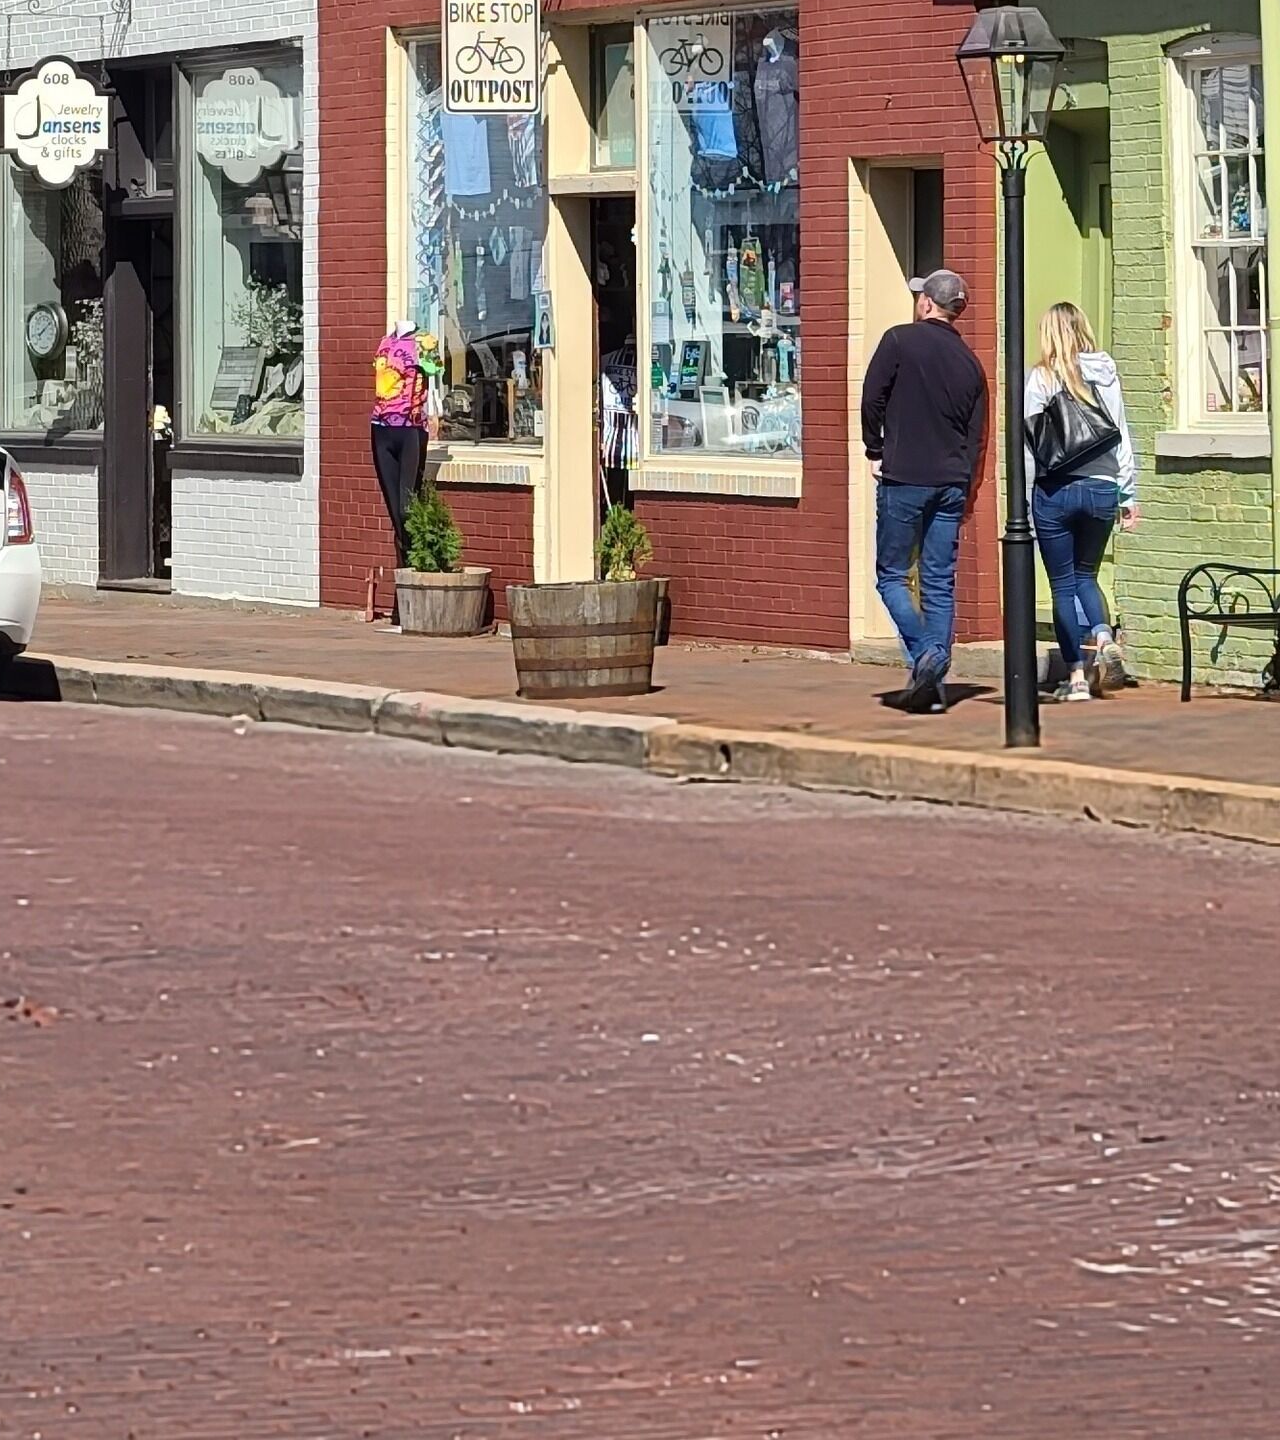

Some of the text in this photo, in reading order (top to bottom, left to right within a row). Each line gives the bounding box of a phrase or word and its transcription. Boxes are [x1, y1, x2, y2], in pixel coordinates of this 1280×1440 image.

[449, 2, 534, 24] BIKE STOP
[43, 73, 70, 86] 608
[450, 79, 535, 104] OUTPOST
[57, 103, 103, 119] Jewelry
[51, 134, 88, 146] clocks
[40, 146, 82, 161] & gifts
